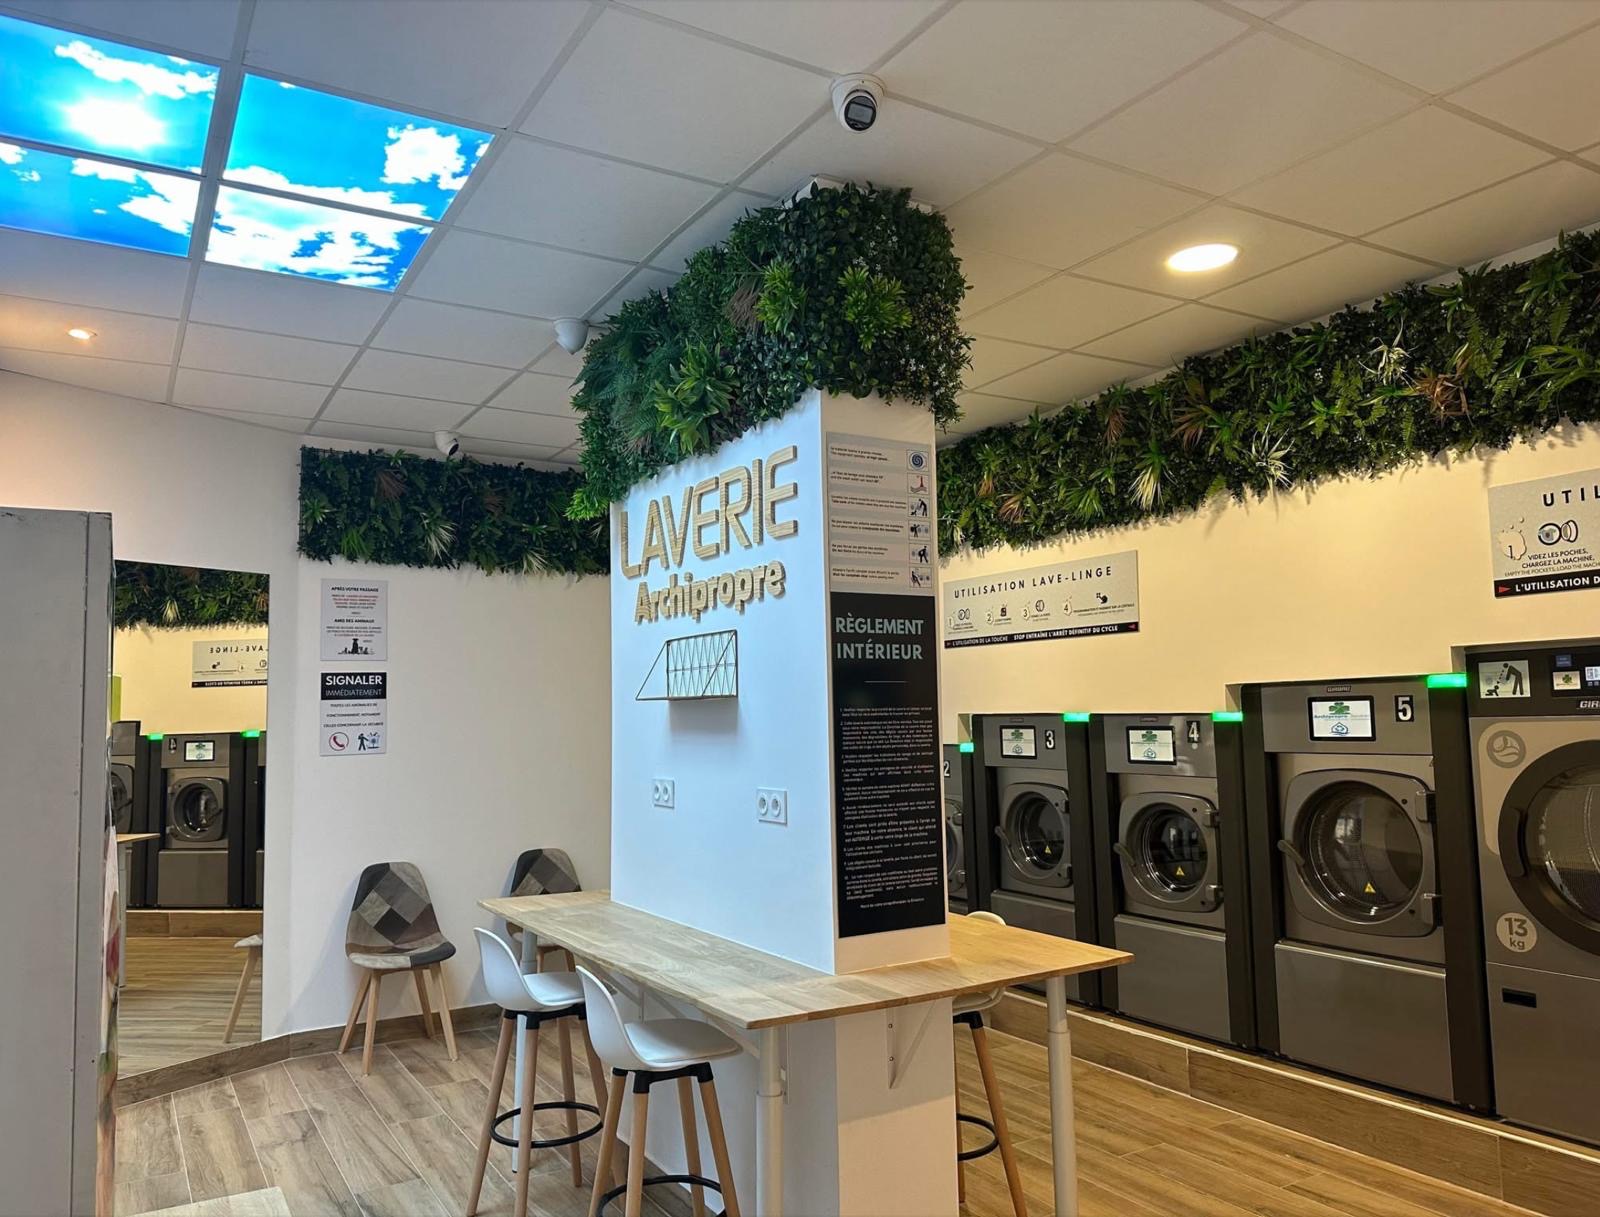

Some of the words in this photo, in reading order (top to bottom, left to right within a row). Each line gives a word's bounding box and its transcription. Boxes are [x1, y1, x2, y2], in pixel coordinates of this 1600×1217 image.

[620, 445, 798, 579] LAVERIE
[1508, 545, 1513, 559] 1
[1522, 560, 1552, 568] CHARGEZ
[954, 580, 1025, 598] UTILISATION
[1032, 566, 1112, 587] LAVE-LINGE
[1515, 576, 1590, 592] L'UTILISATION
[634, 560, 786, 623] Archipropre
[987, 614, 992, 622] 2
[1023, 608, 1028, 617] 3
[1064, 604, 1069, 612] 4
[835, 612, 924, 635] RÈGLEMENT
[837, 639, 923, 660] INTÉRIEUR
[326, 675, 382, 685] SIGNALER
[326, 688, 381, 696] IMMÉDIATEMENT
[1398, 697, 1412, 720] 5
[1046, 730, 1054, 748] 3
[1189, 722, 1199, 741] 4
[944, 761, 950, 777] 2
[1504, 918, 1528, 937] 13
[1510, 937, 1525, 950] kg
